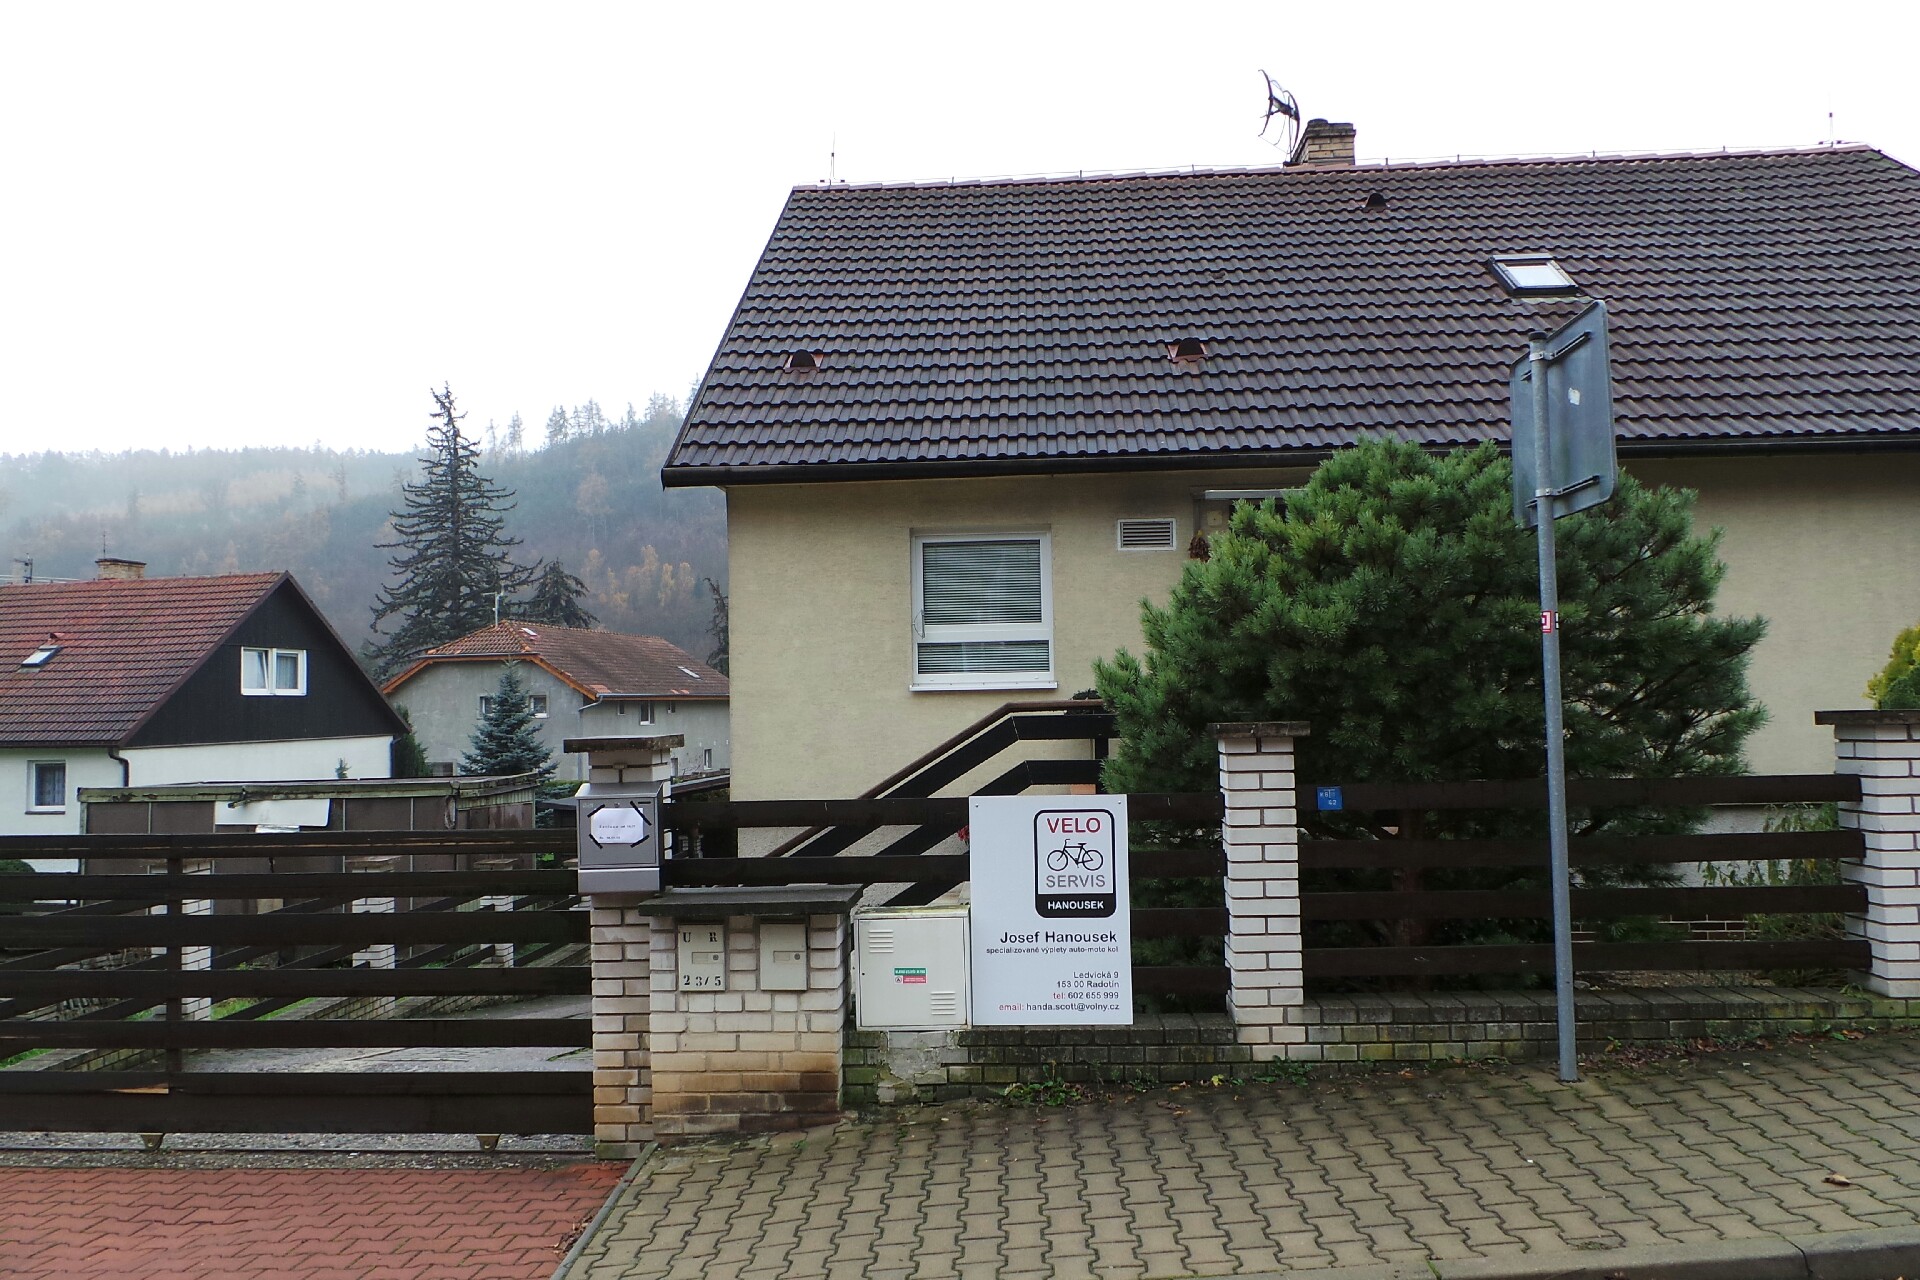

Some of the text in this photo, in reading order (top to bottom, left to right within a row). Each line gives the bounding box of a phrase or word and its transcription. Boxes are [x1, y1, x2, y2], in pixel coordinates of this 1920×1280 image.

[1046, 817, 1101, 833] VELO
[1046, 874, 1106, 888] SERVIS
[1047, 900, 1104, 910] HANOUSEK
[683, 932, 717, 942] U R
[1000, 929, 1117, 943] Josef Hanousek
[986, 946, 1040, 954] specializované
[1041, 946, 1067, 954] výplety
[1068, 946, 1106, 954] auto-moto
[1073, 971, 1119, 979] Ledvická 9
[1086, 980, 1120, 988] Radotín
[1053, 992, 1066, 1000] tel:
[1067, 992, 1084, 1000] 602
[1086, 992, 1102, 1000] 655
[999, 1003, 1120, 1012] email: handa.scott@volny.cz
